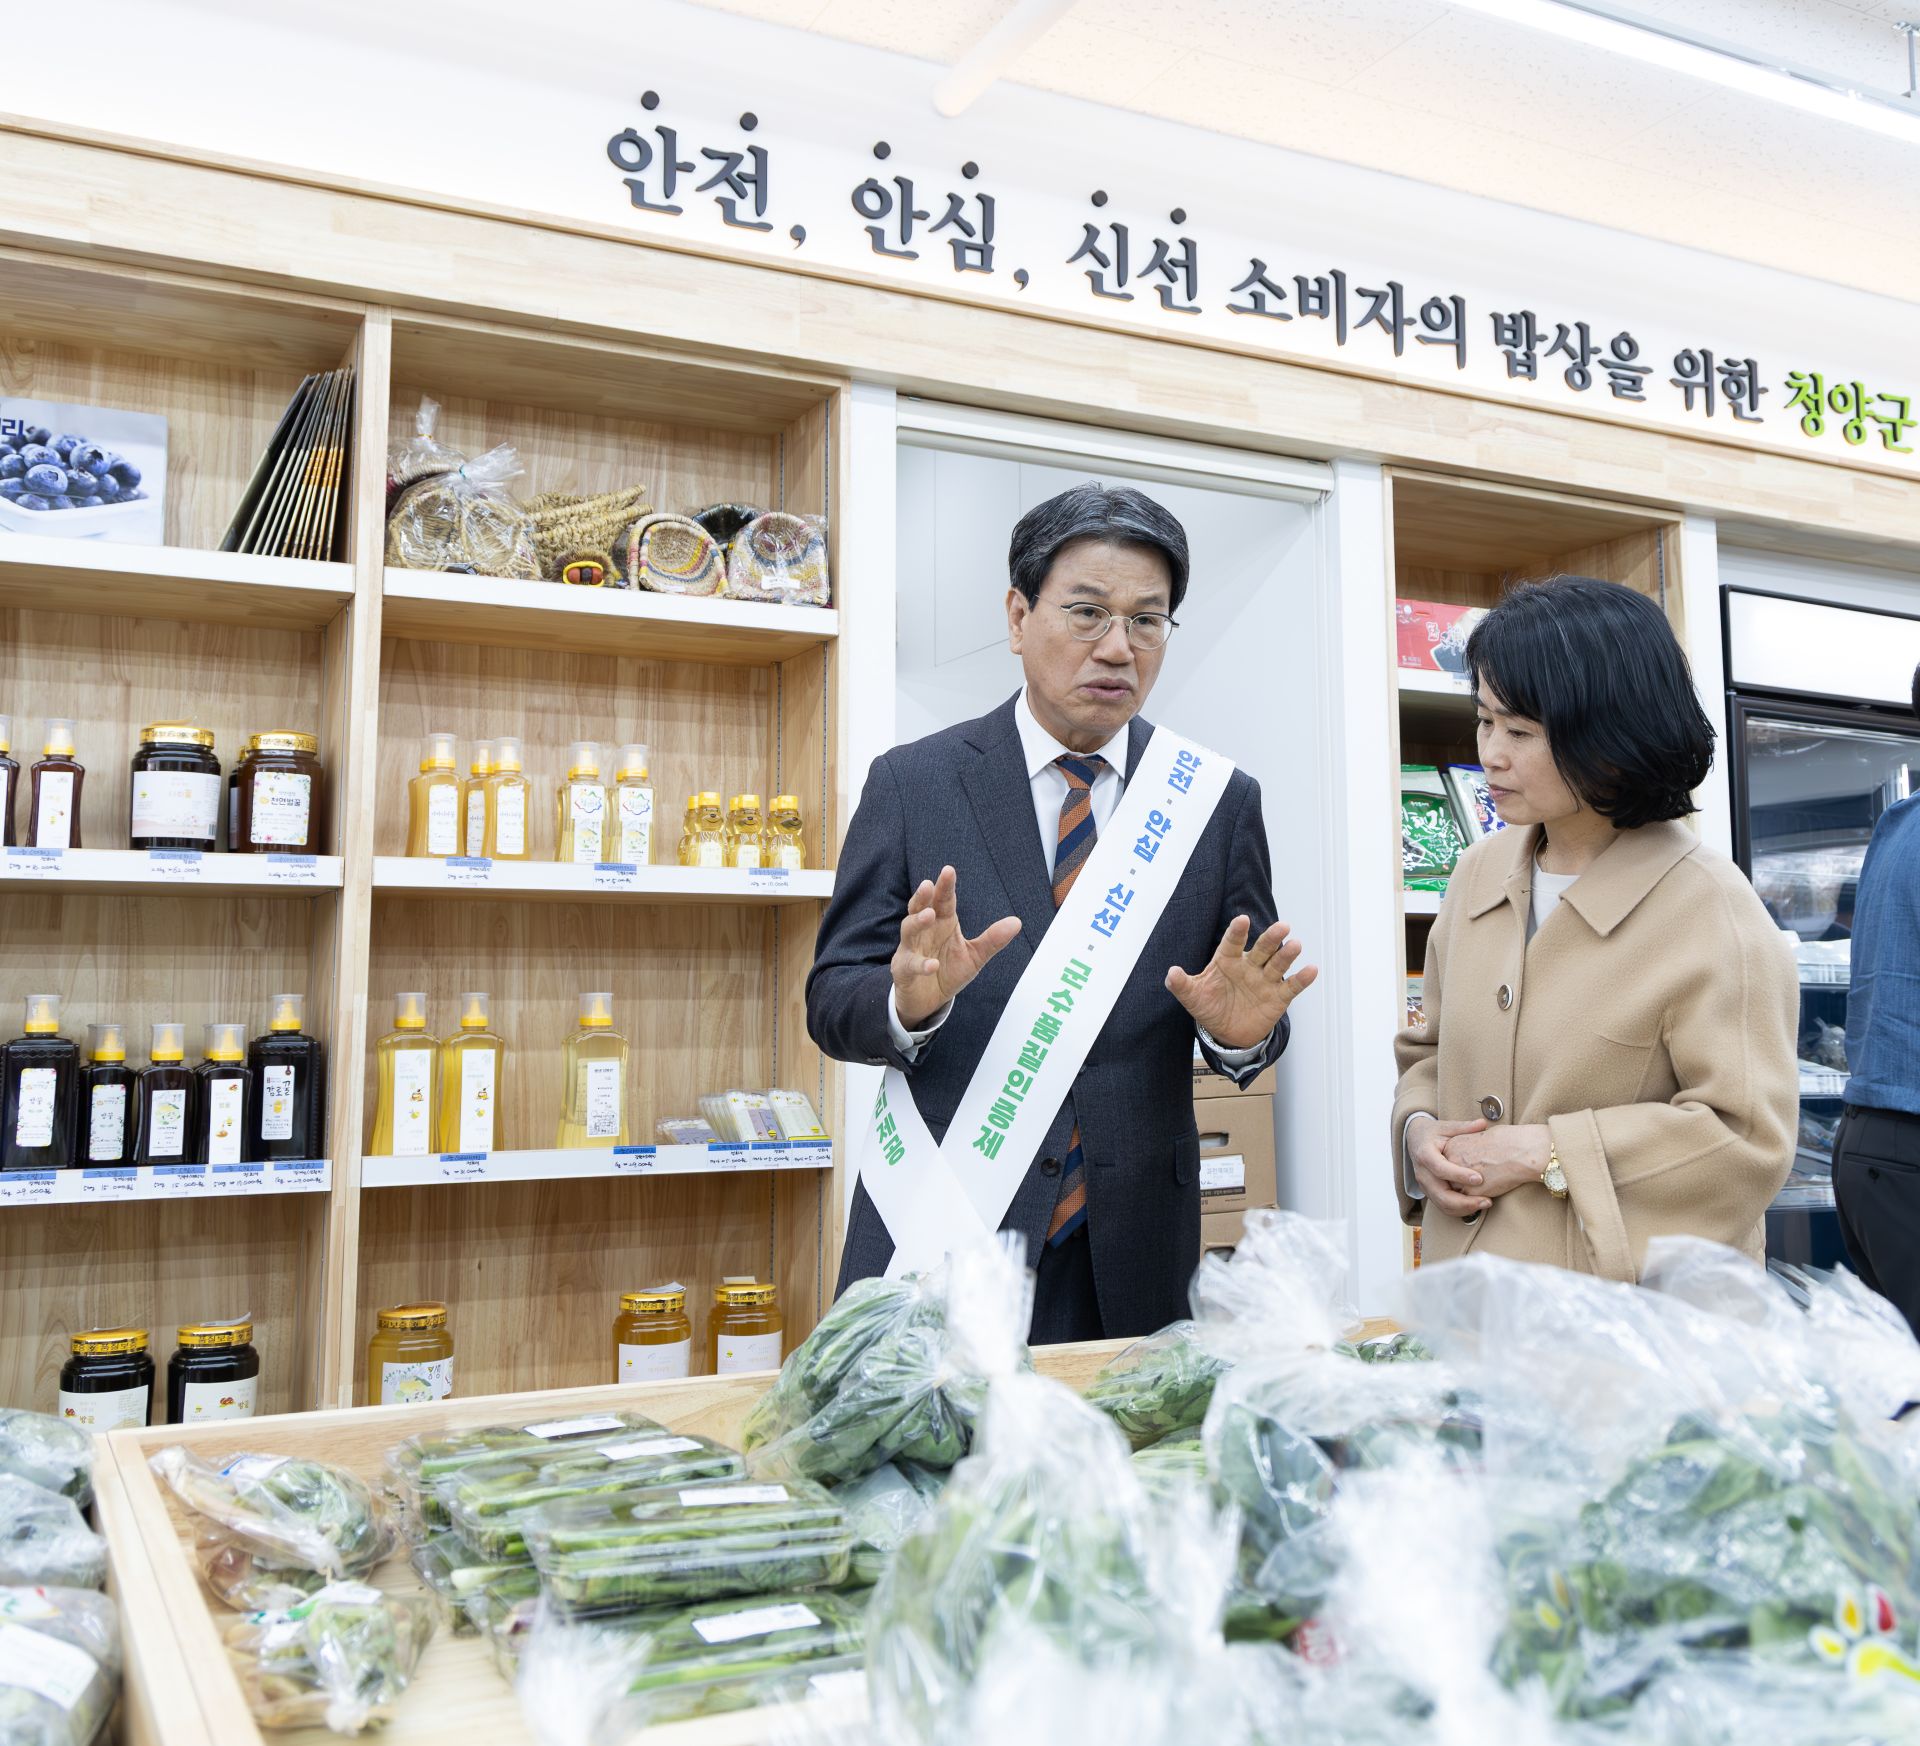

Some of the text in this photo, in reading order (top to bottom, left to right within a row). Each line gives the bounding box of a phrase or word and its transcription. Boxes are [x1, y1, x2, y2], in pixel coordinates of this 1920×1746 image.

[0, 417, 24, 438] 리
[606, 124, 1918, 455] 안전, 안심, 신선 소비자의 밥상을 위한 청양군
[972, 749, 1203, 1161] 안전 안심 신선 군수품질인증제
